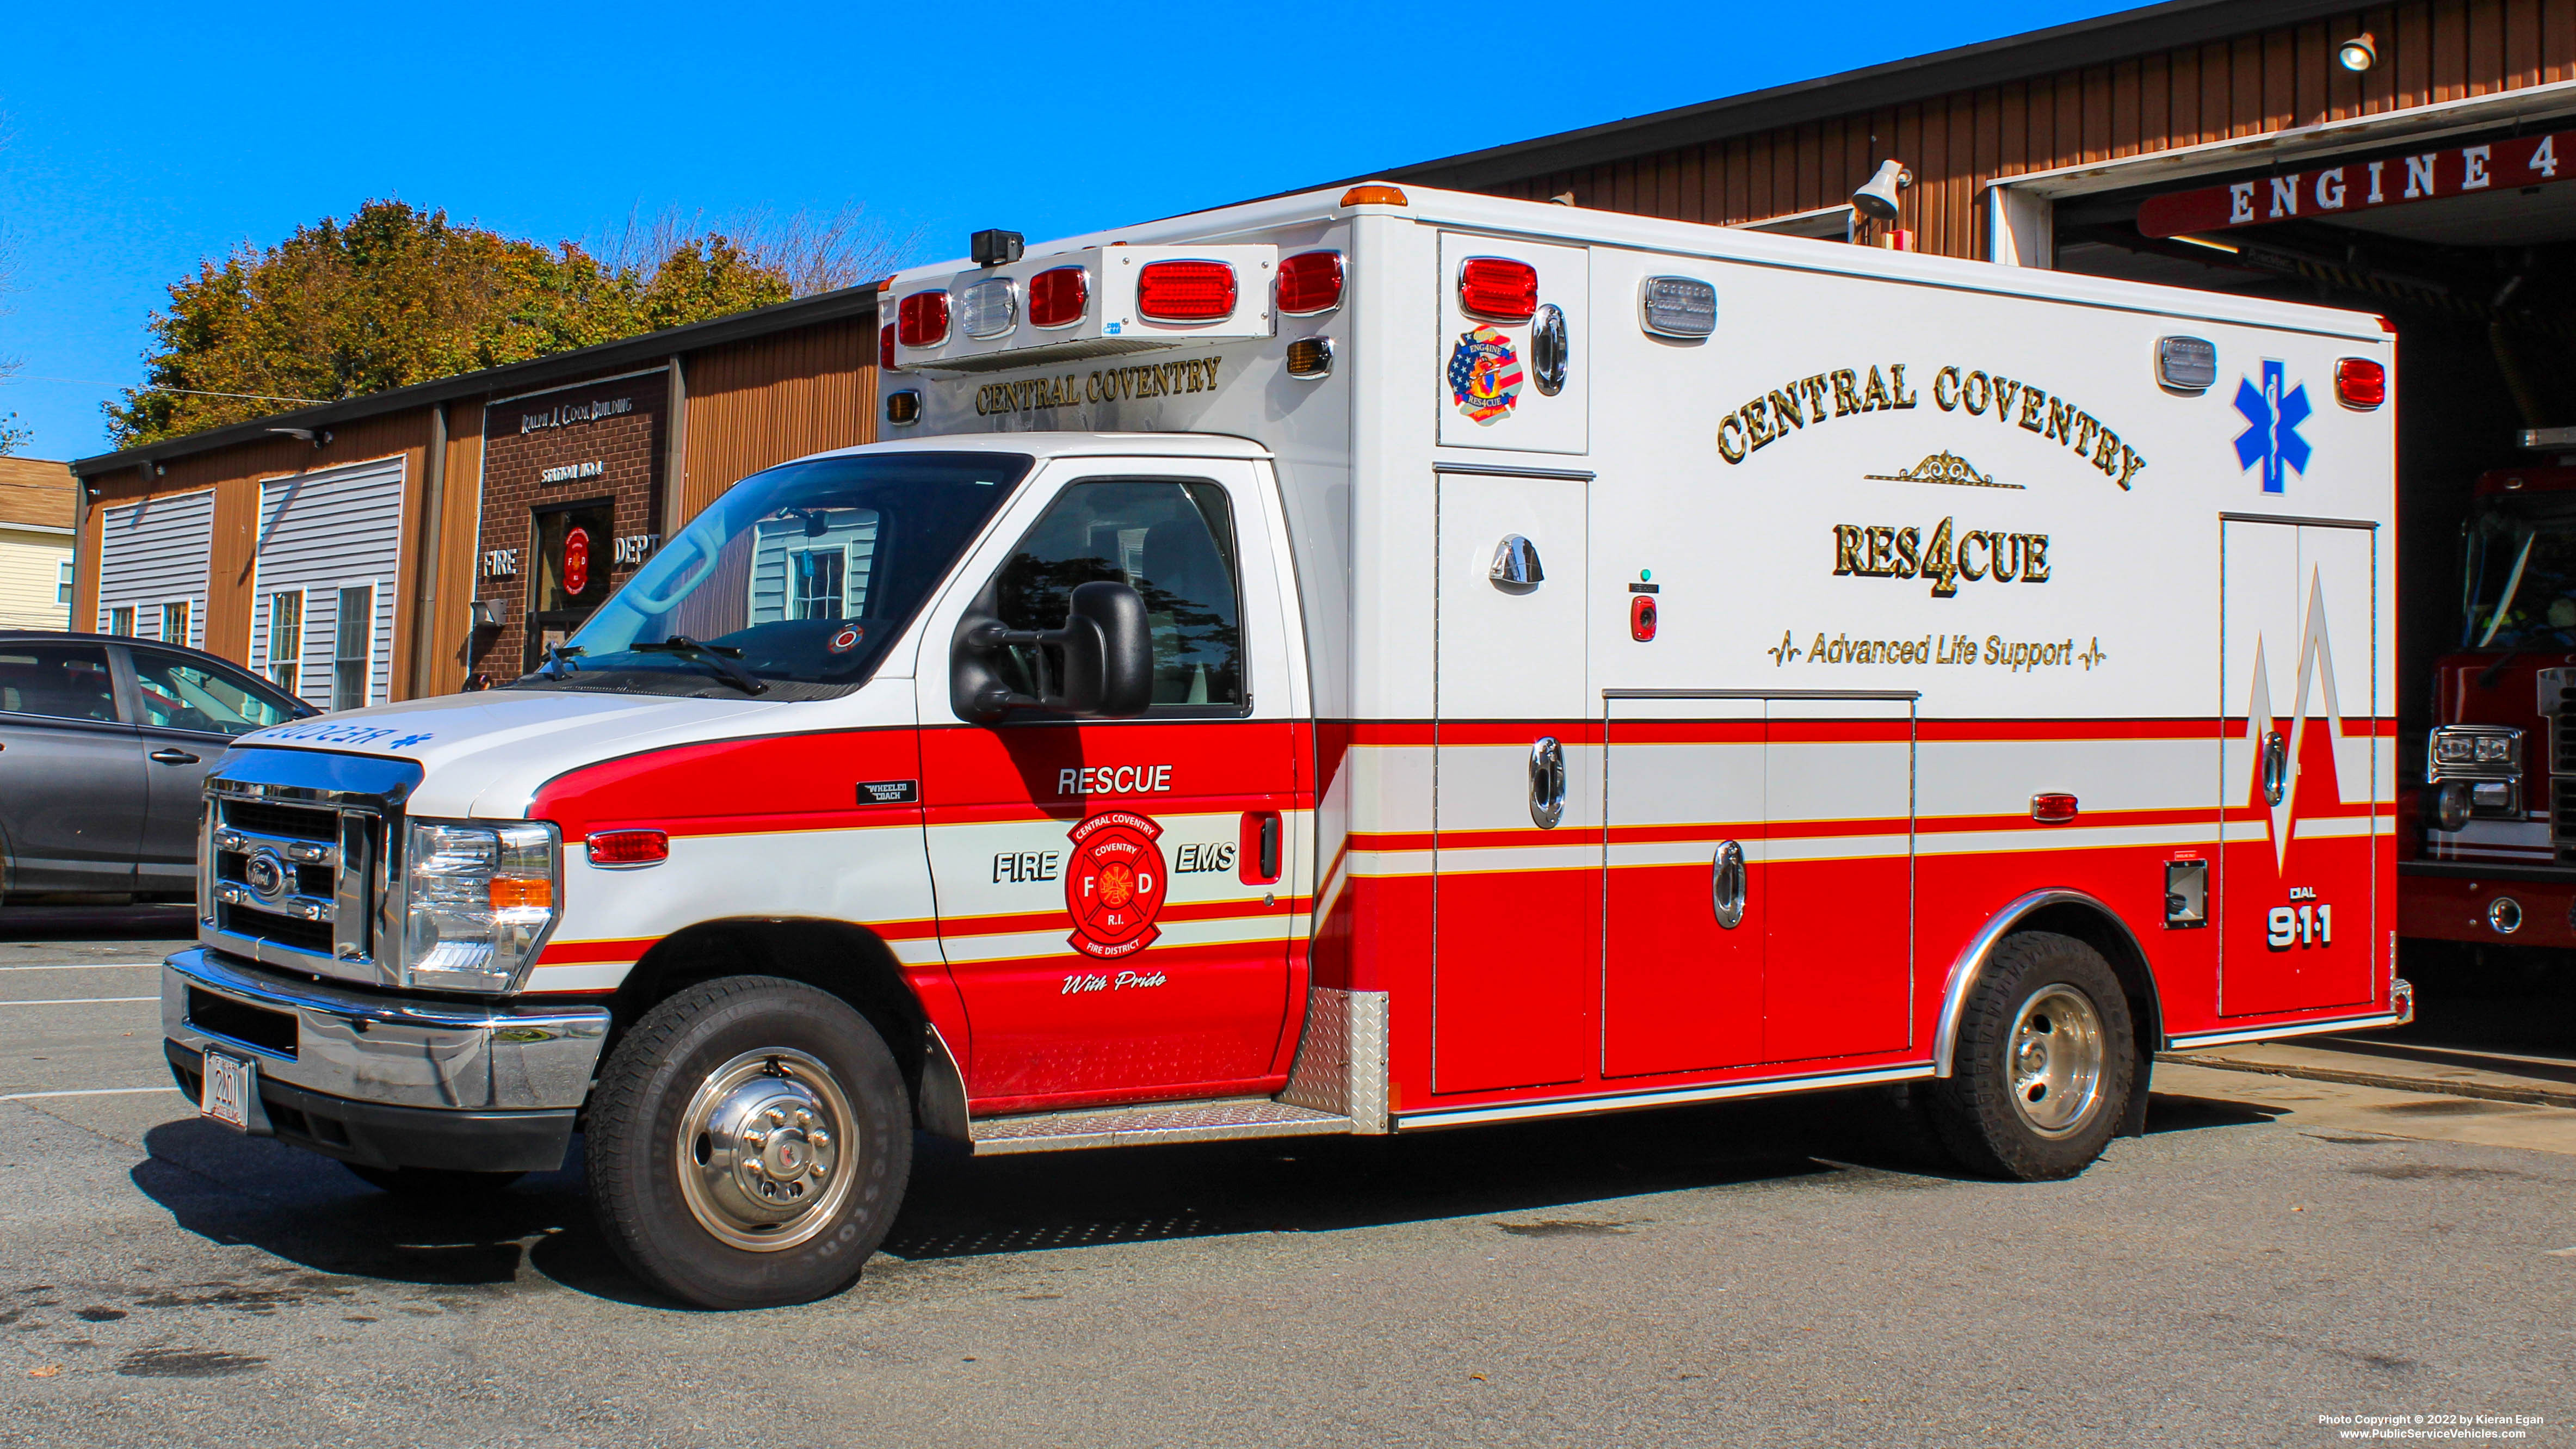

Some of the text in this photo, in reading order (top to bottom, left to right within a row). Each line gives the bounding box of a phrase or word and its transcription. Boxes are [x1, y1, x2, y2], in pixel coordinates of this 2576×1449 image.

[2229, 135, 2558, 224] ENGINE 4
[1469, 343, 1502, 355] ENG4INE
[975, 356, 1221, 416] CENTRAL COVENTRY
[1468, 394, 1502, 407] RES4CUE
[521, 413, 548, 434] RALPH
[563, 405, 590, 424] COOK
[591, 398, 632, 420] BUILDING
[1718, 363, 2146, 491] CENTRAL COVENTRY
[541, 464, 579, 483] STATION
[614, 534, 661, 564] DEPT
[1832, 516, 2050, 599] RES4CUE
[484, 548, 518, 576] FIRE
[1808, 633, 2074, 673] Advanced Life Support
[865, 784, 907, 793] WHEELED
[1058, 764, 1172, 794] RESCUE
[872, 792, 901, 800] COACH
[1076, 814, 1155, 840] CENTRAL COVENTRY
[1095, 843, 1138, 857] COVENTRY
[1175, 841, 1237, 873] EMS
[252, 862, 270, 886] Ford
[993, 850, 1059, 883] FIRE
[1084, 873, 1152, 897] F D
[2289, 886, 2317, 902] DIAL
[1108, 915, 1124, 926] R.I.
[1086, 939, 1139, 955] FIRE DISTRICT
[1061, 970, 1167, 995] With Pride
